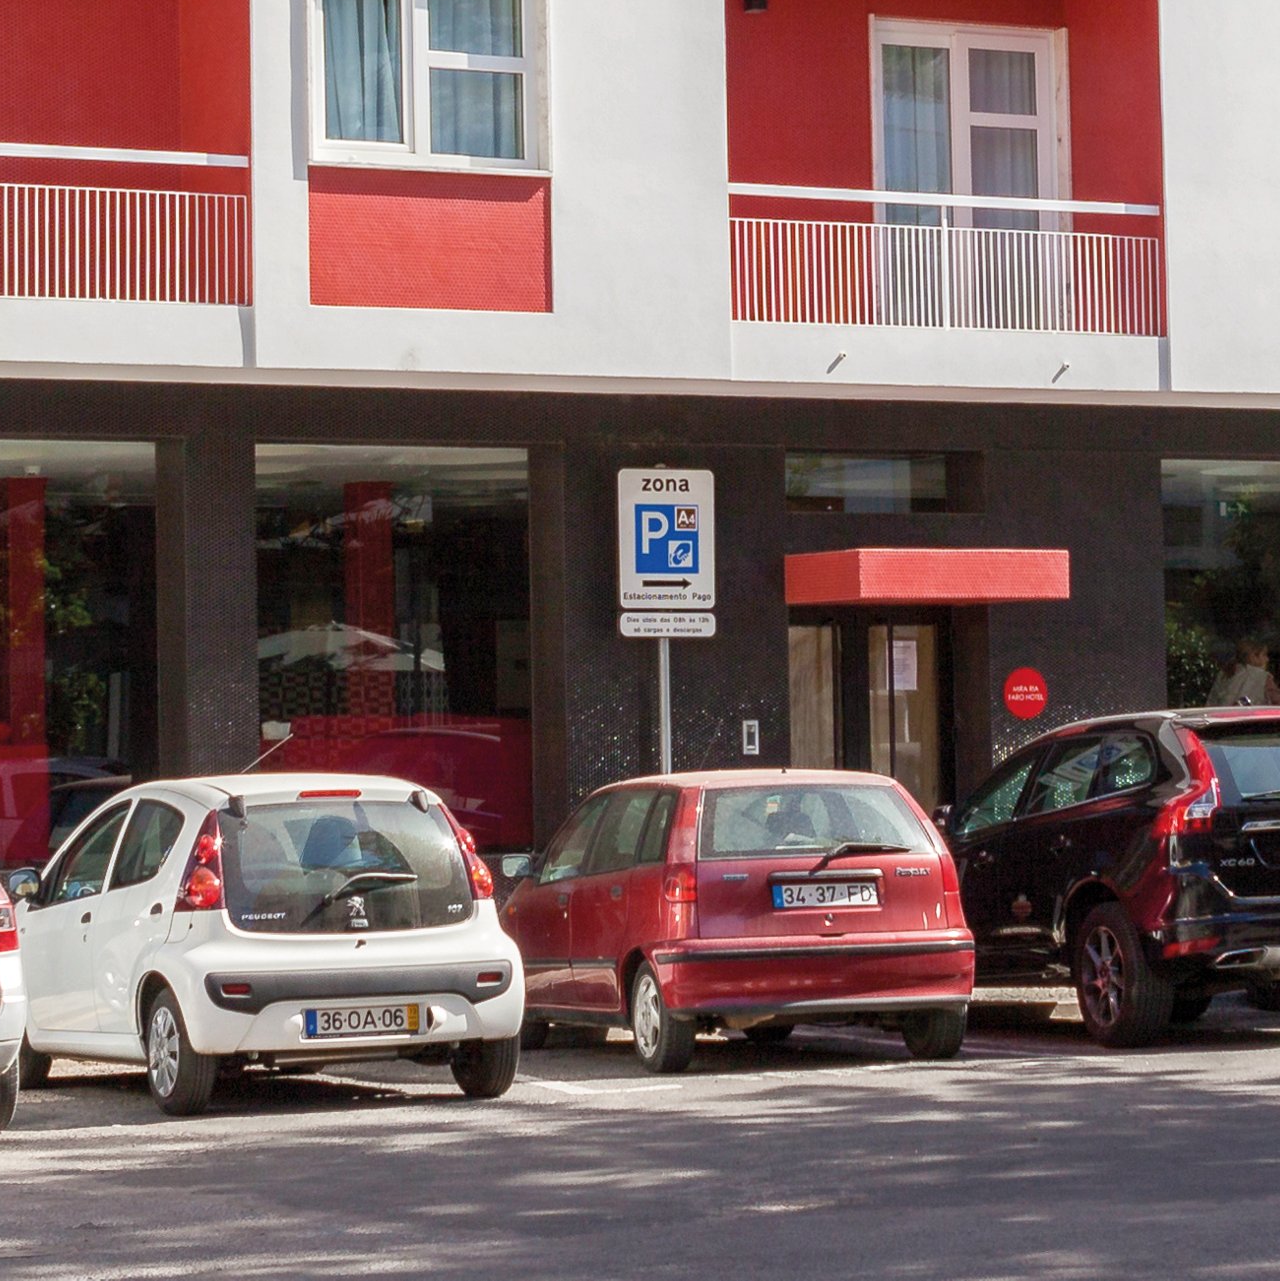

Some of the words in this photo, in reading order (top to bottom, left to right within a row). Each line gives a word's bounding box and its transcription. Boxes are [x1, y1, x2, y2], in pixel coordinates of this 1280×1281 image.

[641, 478, 690, 492] zona
[641, 511, 669, 554] P
[677, 510, 696, 525] A4
[623, 592, 688, 601] Estacionamento
[692, 592, 712, 602] Pago
[241, 912, 286, 920] PEUGEOT
